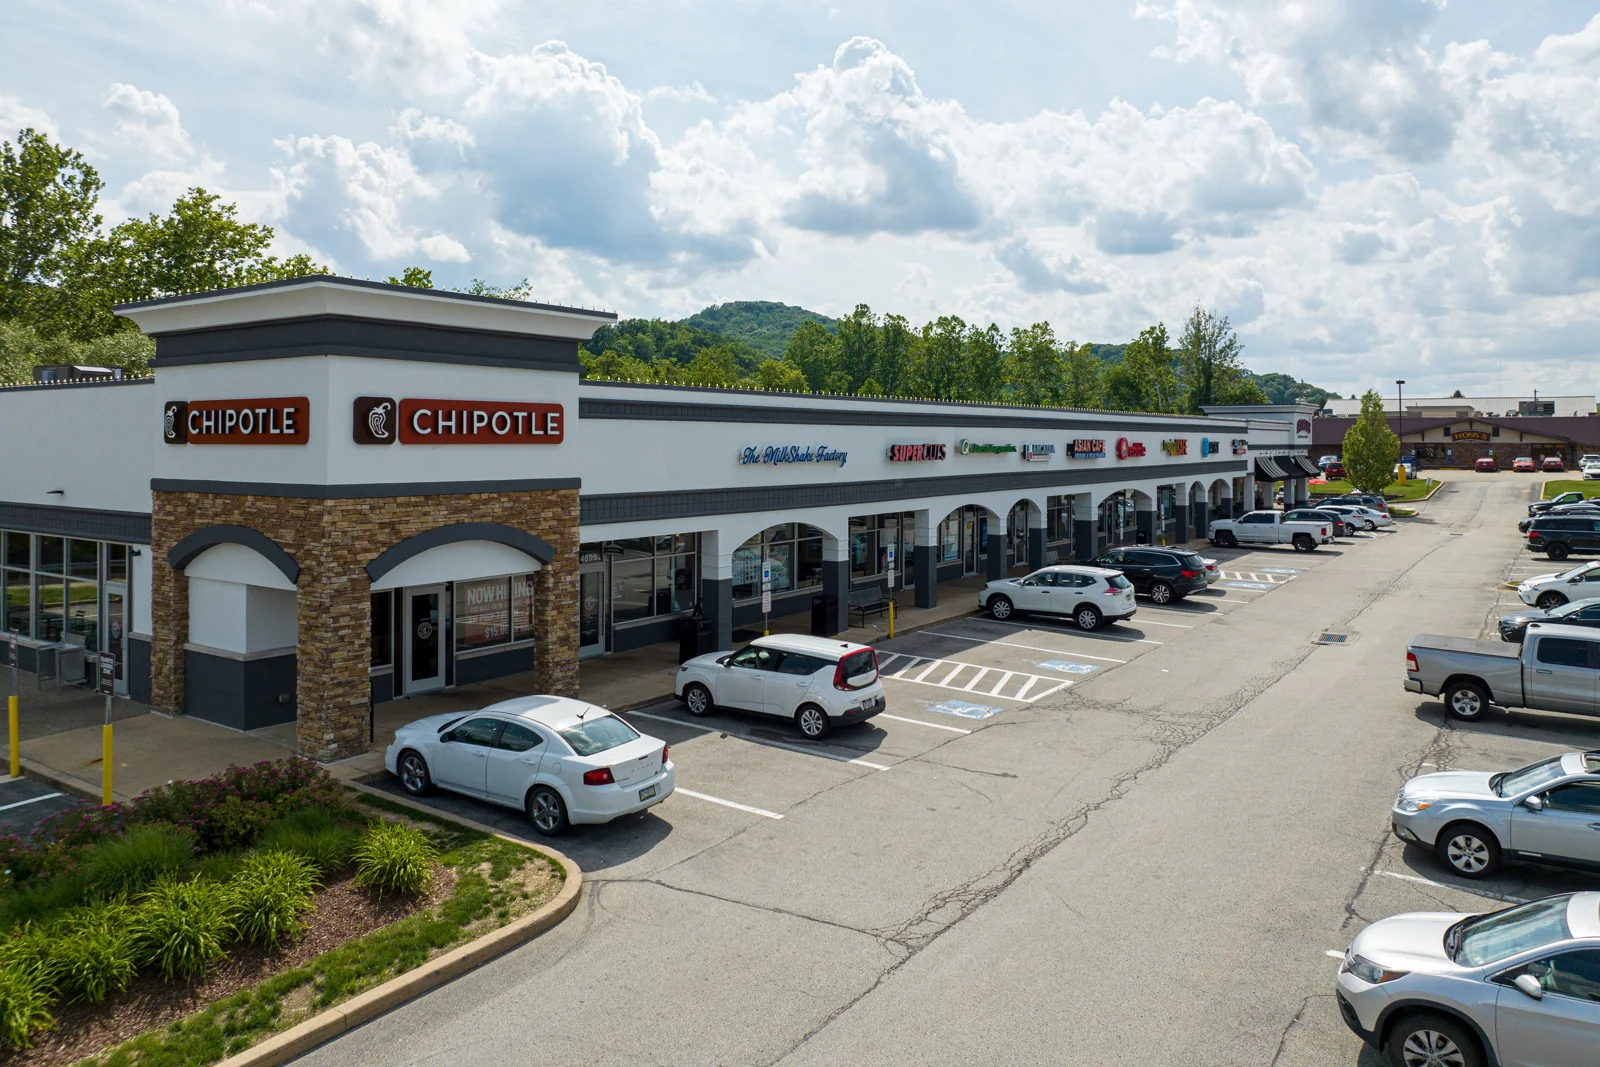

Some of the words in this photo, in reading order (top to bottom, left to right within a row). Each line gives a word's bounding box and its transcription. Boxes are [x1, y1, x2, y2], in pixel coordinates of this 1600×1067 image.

[188, 407, 295, 435] CHIPOTLE
[412, 408, 560, 435] CHIPOTLE
[742, 446, 760, 465] The
[816, 445, 848, 468] Factory
[891, 443, 947, 462] SUPERCUTS
[1074, 439, 1091, 452] ASIAN
[467, 586, 495, 605] NOW
[496, 581, 535, 601] HIING
